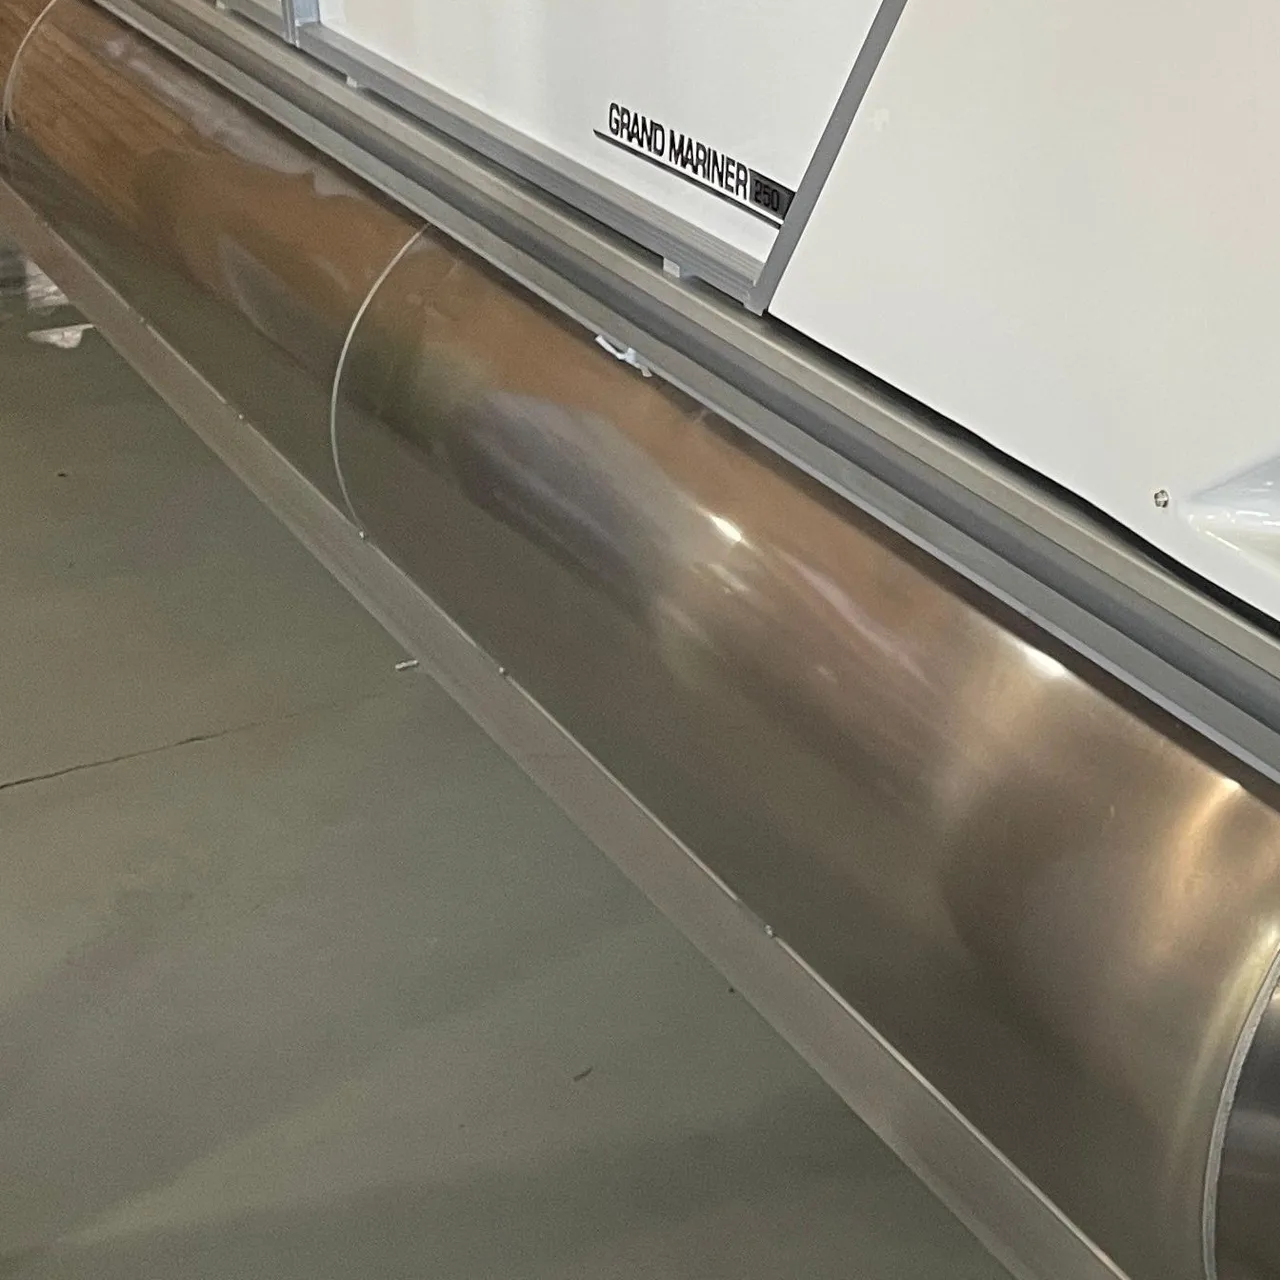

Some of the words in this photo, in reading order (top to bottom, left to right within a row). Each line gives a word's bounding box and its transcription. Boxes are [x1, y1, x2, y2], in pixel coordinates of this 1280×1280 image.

[608, 102, 665, 157] GRAND
[669, 129, 749, 200] MARINER
[754, 179, 781, 212] 250
